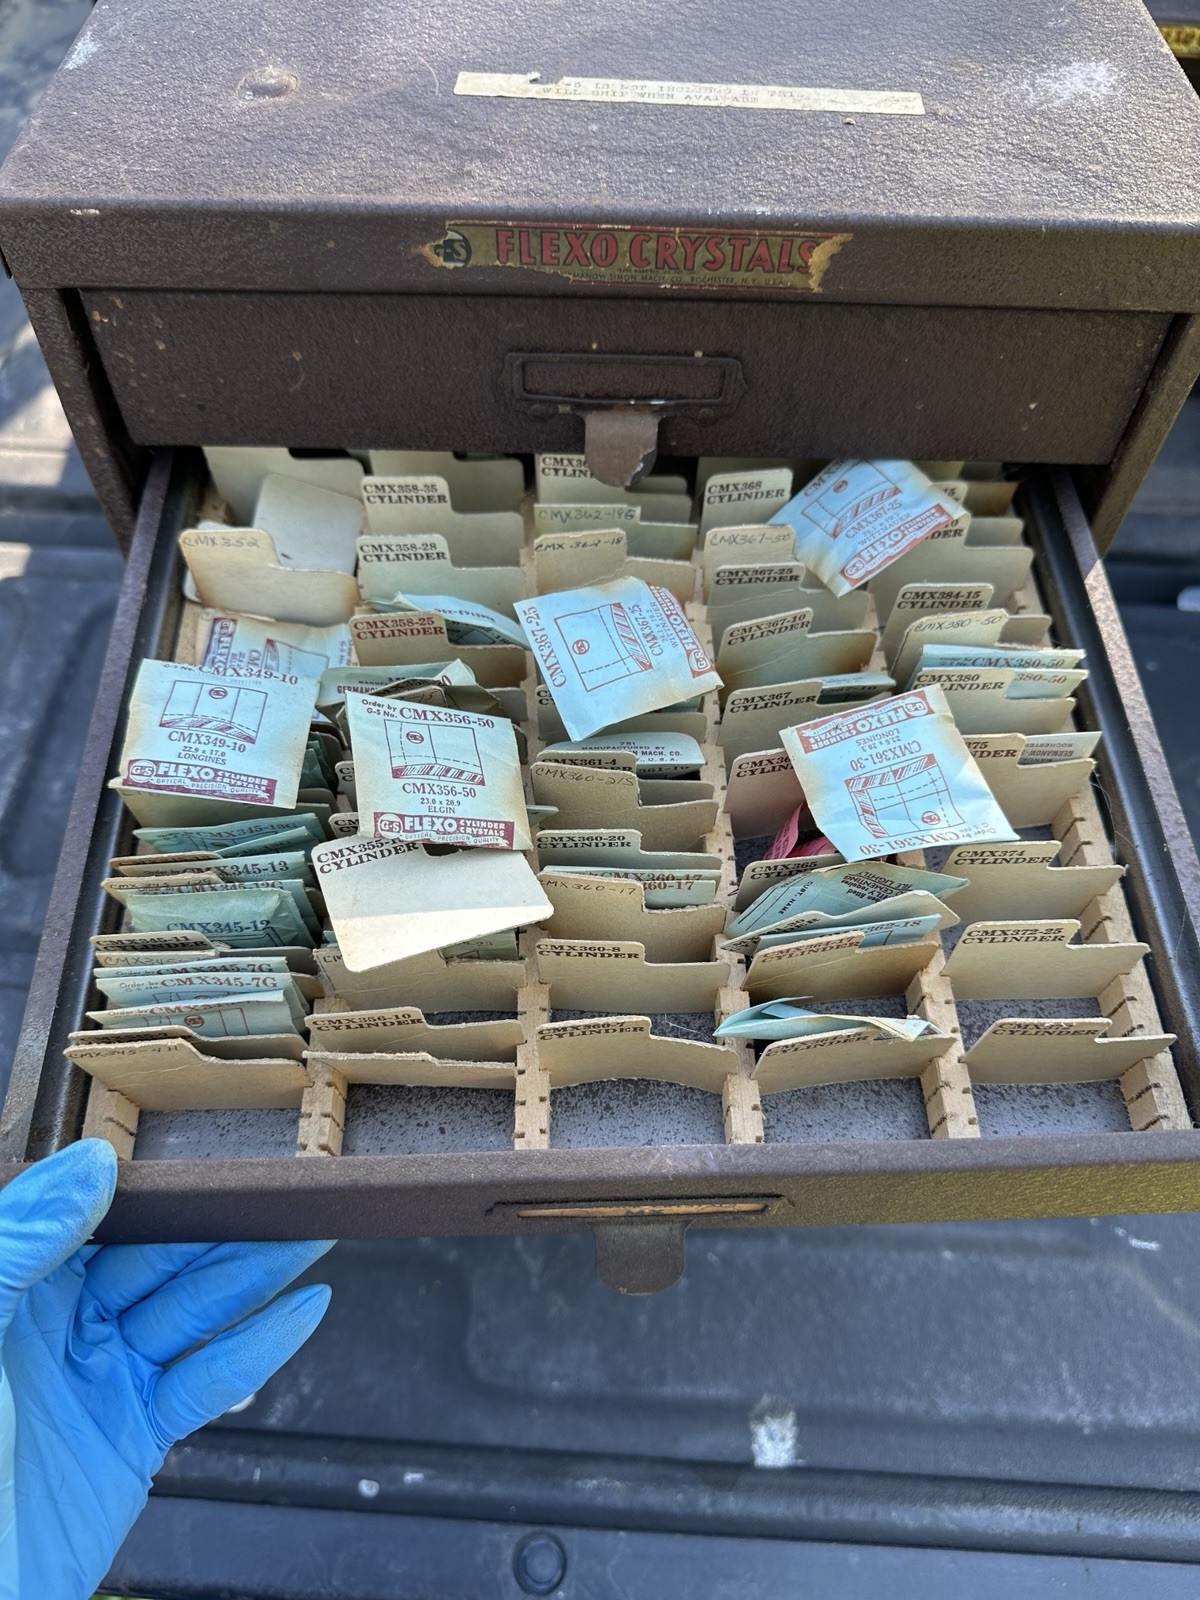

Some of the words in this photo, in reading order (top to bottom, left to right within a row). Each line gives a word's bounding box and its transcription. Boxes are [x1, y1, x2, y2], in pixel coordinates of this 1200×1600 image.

[591, 90, 628, 98] SHIP
[638, 92, 674, 100] WHEN
[495, 228, 618, 268] FLEXO
[629, 232, 818, 274] CRYSTALS
[363, 483, 438, 494] CMX358-35
[708, 481, 762, 493] CMX368
[366, 494, 448, 506] CYLINDER
[706, 489, 785, 505] CYLINDER
[360, 542, 437, 553] CMX358-28
[362, 551, 448, 563] CYLINDER
[715, 568, 794, 578] CMX367-25
[715, 574, 800, 586] CYLINDER
[900, 590, 981, 600] CMX384-15
[897, 600, 984, 610] CYLINDER
[354, 616, 434, 631] CMX358-25
[628, 604, 664, 657] CMX367-25
[650, 601, 679, 648] WITTNAUER
[729, 614, 806, 638] CMX367-10
[356, 626, 445, 641] CYLINDER
[668, 614, 696, 652] FLEXO
[728, 621, 811, 646] CYLINDER
[523, 606, 568, 688] CMX367-25
[198, 666, 298, 686] CMX349-10
[916, 674, 980, 684] CMX380
[1014, 672, 1067, 684] 380-50
[362, 698, 384, 709] Order
[387, 702, 397, 712] by
[730, 692, 792, 706] CMX367
[730, 695, 816, 714] CYLINDER
[366, 708, 381, 716] G-S
[384, 710, 398, 719] No.
[400, 707, 495, 729] CMX356-50
[856, 707, 906, 733] FLEXO
[168, 730, 247, 754] CMX349-10
[856, 728, 900, 746] LONGINES
[178, 752, 227, 766] LONGINES
[850, 740, 922, 772] CMX361-30
[156, 762, 216, 780] FLEXO
[217, 770, 269, 786] CYLINDER
[402, 782, 476, 798] CMX356-50
[428, 805, 456, 814] ELGIN
[446, 799, 462, 807] 20.9
[404, 817, 458, 833] FLEXO
[460, 826, 506, 836] CRYSTALS
[460, 819, 506, 830] CYLINDER
[404, 832, 433, 840] OPTICAL
[437, 834, 471, 842] PRECISION
[859, 829, 959, 857] CMX361-30
[536, 842, 632, 850] CYLINDER
[319, 842, 419, 875] CYLINDER
[954, 856, 1054, 866] CYLINDER
[956, 850, 1026, 858] CMX374
[841, 878, 869, 893] requires
[844, 874, 894, 896] CEMENTING
[856, 870, 894, 887] LIGHTLY
[778, 896, 797, 915] NAME
[166, 919, 271, 934] CMX345-12
[966, 928, 1064, 938] CMX372-25
[103, 940, 208, 952] CYLINDER
[962, 935, 1066, 945] CYLINDER
[536, 944, 621, 952] CMX360-8
[538, 950, 640, 959] CYLINDER
[761, 942, 861, 963] CYLINDER
[118, 982, 145, 990] Order
[161, 976, 278, 988] CMX345-7G
[312, 1013, 412, 1026] CMX356-10
[316, 1018, 425, 1032] CYLINDER
[538, 1022, 625, 1036] CMX360-7
[540, 1026, 645, 1041] CYLINDER
[766, 1036, 870, 1057] CYLINDER
